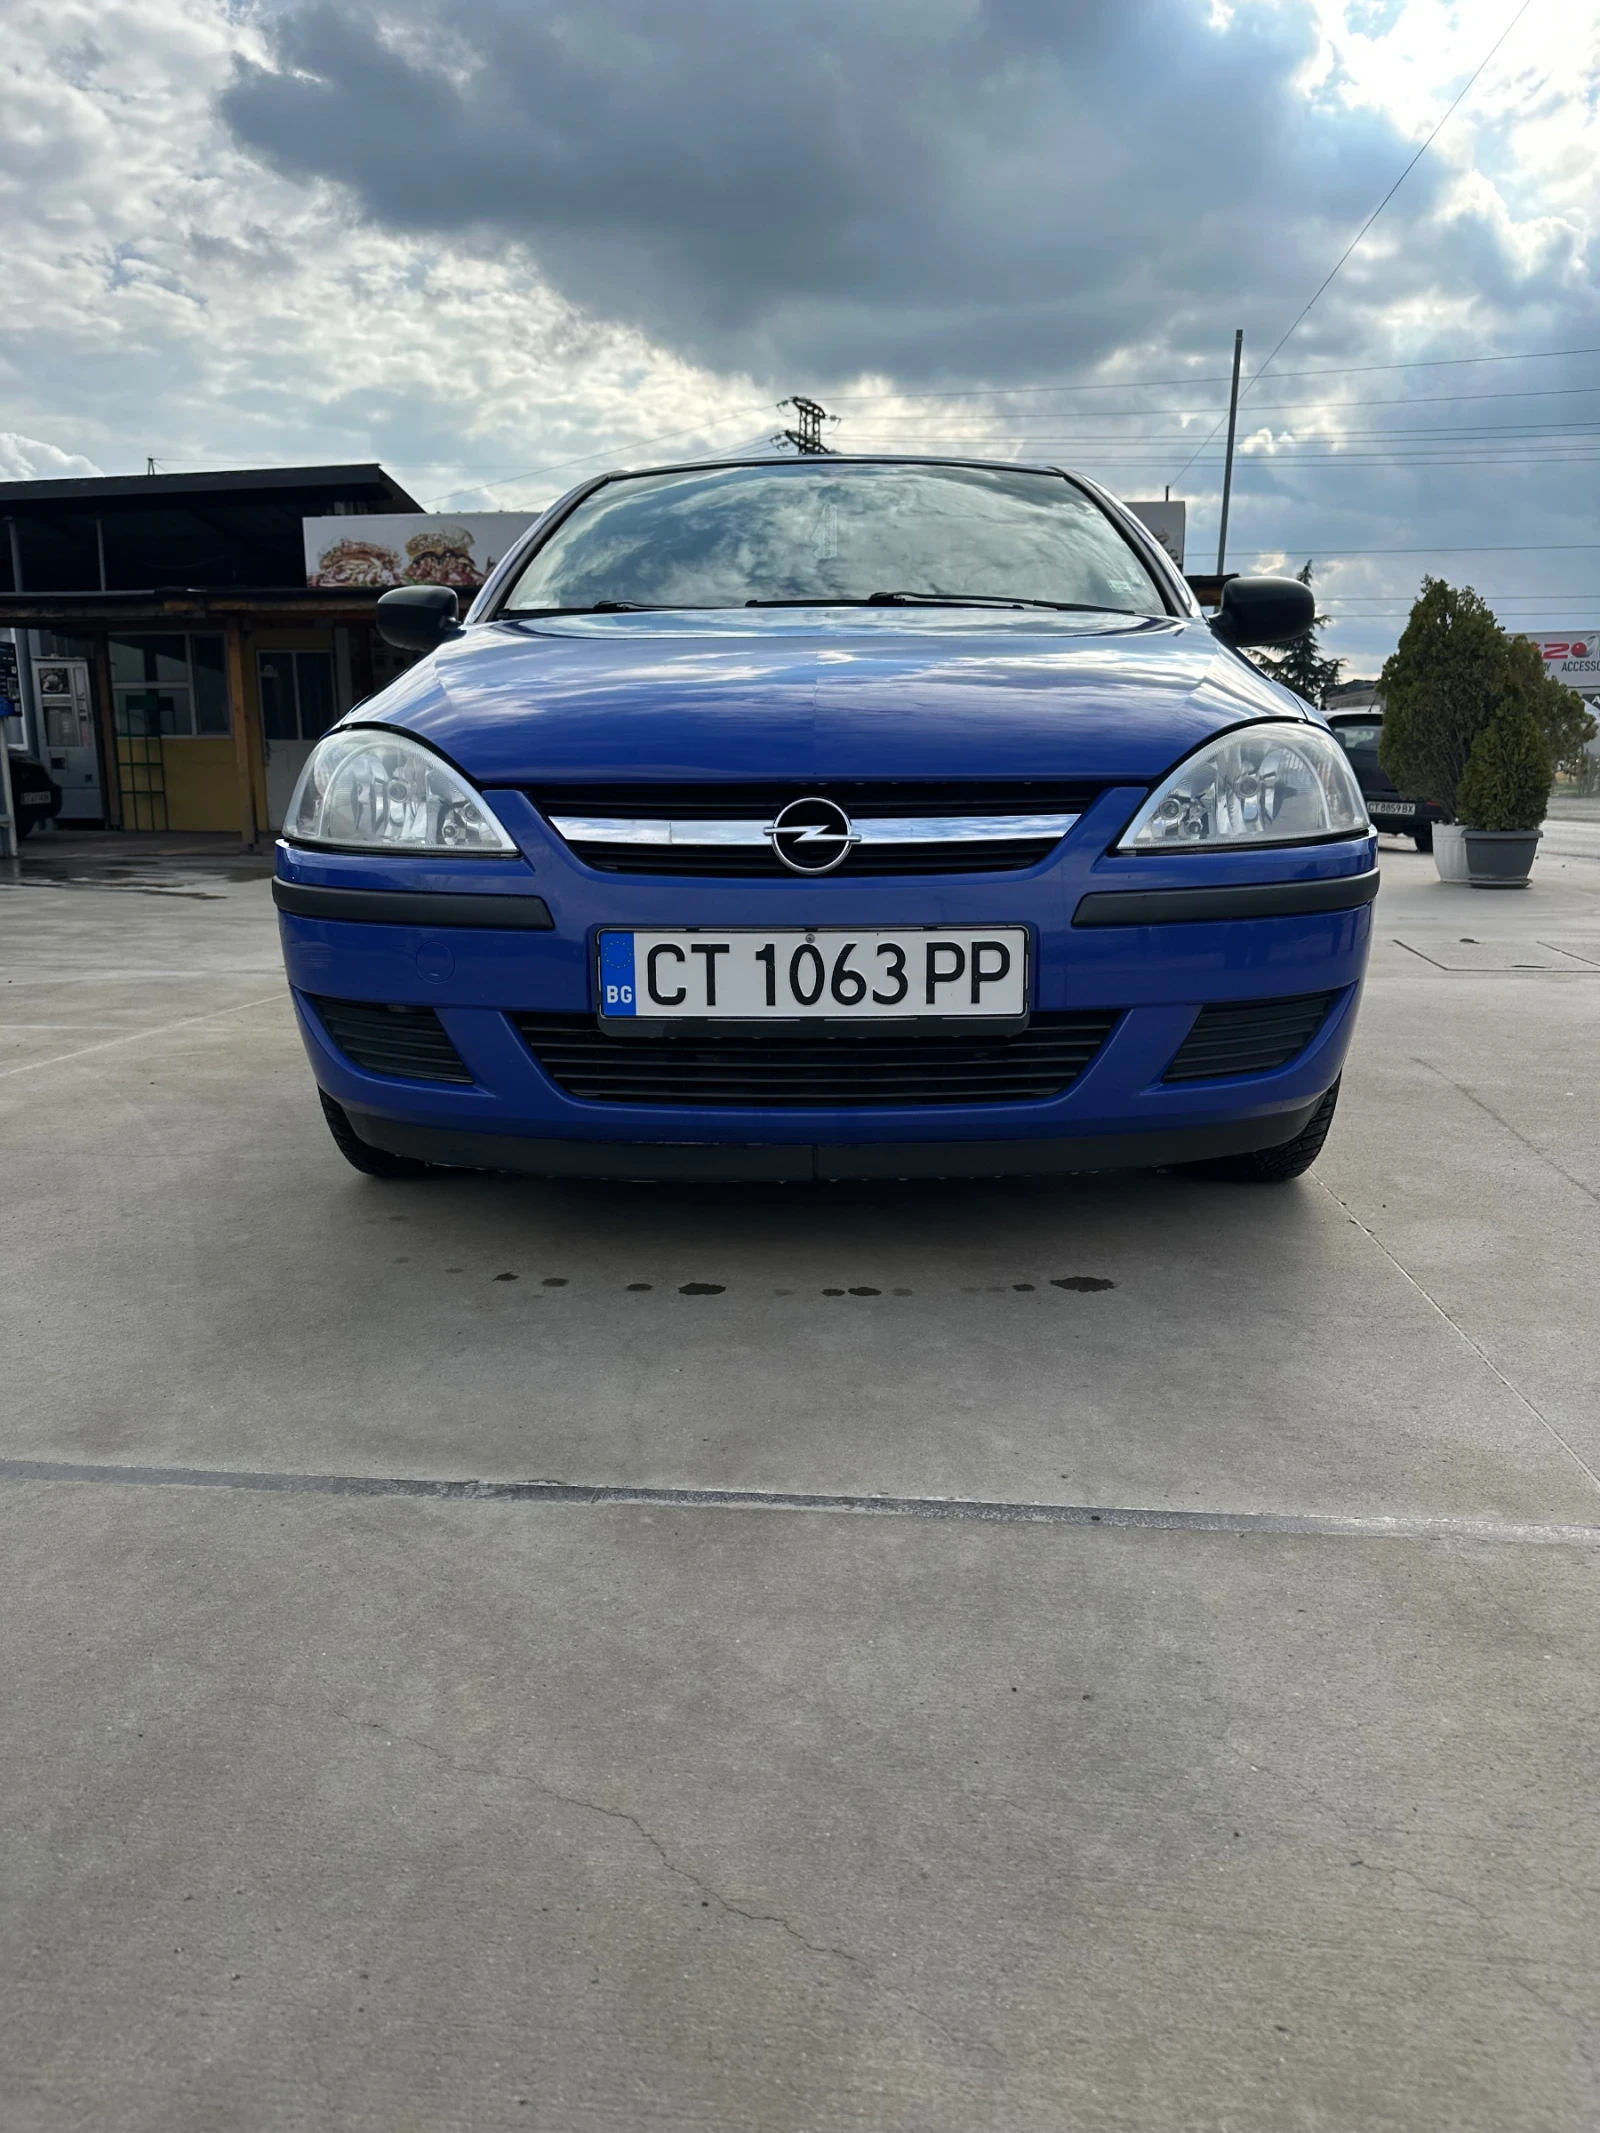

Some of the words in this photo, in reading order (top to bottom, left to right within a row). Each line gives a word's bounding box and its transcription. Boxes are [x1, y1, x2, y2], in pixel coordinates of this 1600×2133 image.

[1402, 804, 1414, 814] BX
[646, 943, 730, 1006] CT
[755, 942, 909, 1006] 1063
[925, 941, 1011, 1005] PP
[606, 985, 633, 1004] BG
